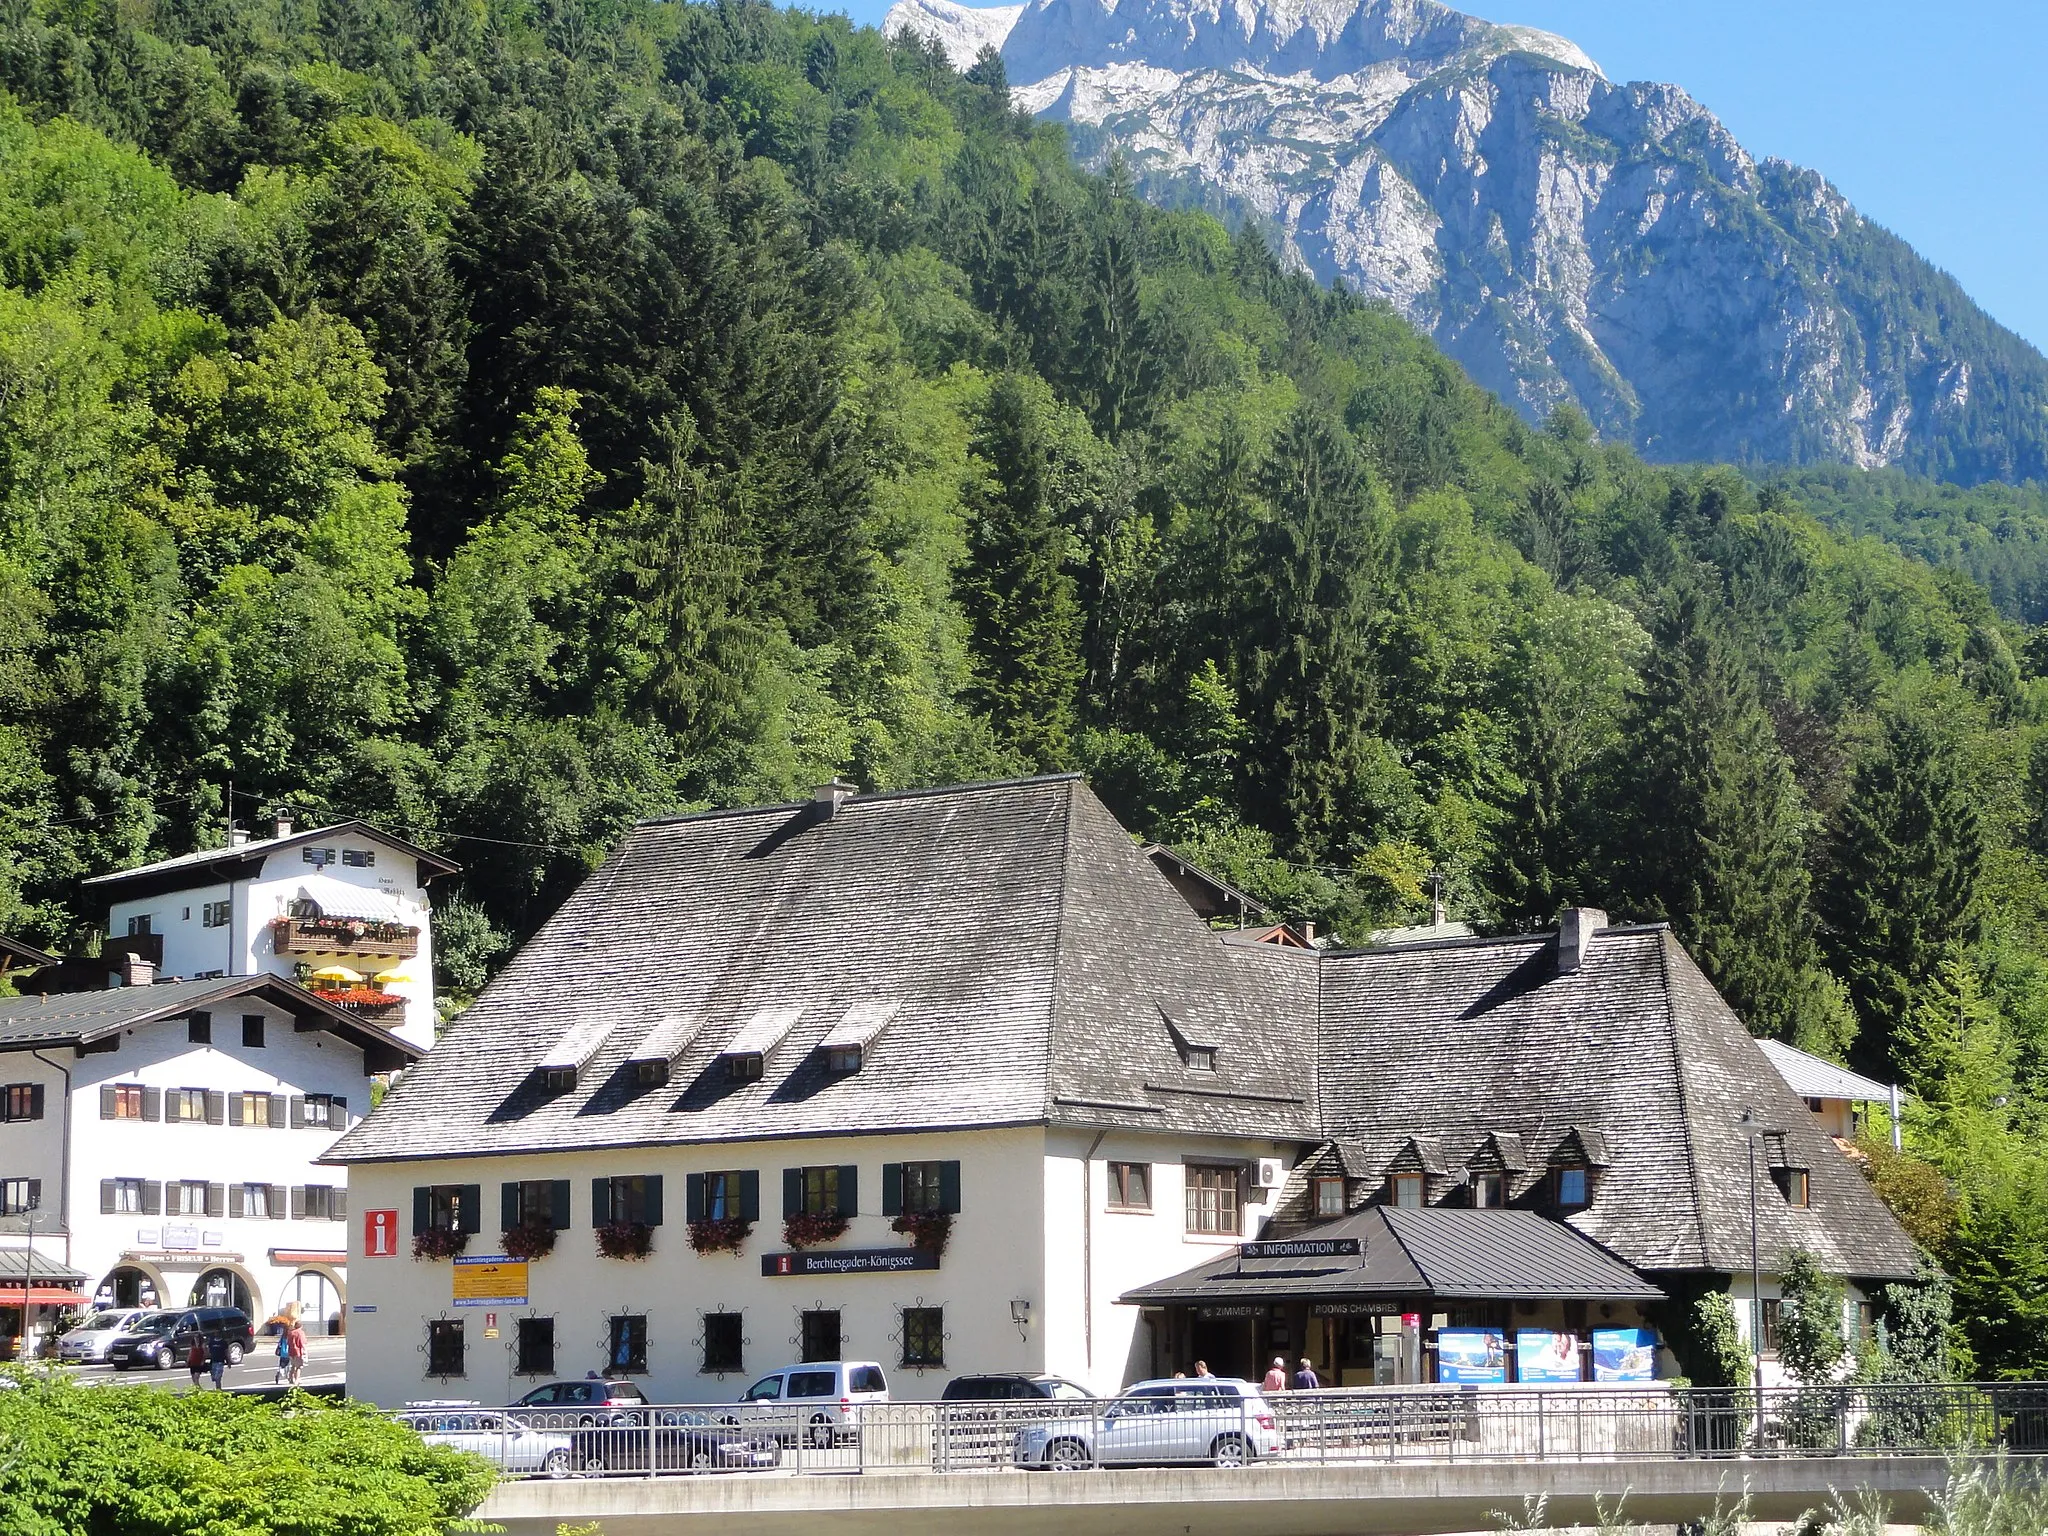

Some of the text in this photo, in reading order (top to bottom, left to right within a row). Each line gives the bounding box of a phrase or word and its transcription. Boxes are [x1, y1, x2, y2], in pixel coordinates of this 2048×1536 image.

[1263, 1242, 1335, 1255] INFORMATION
[806, 1255, 914, 1272] Berchtesgaden-Königssee
[1216, 1306, 1251, 1316] ZIMMER
[1315, 1303, 1398, 1314] ROOMS CHAMBRES
